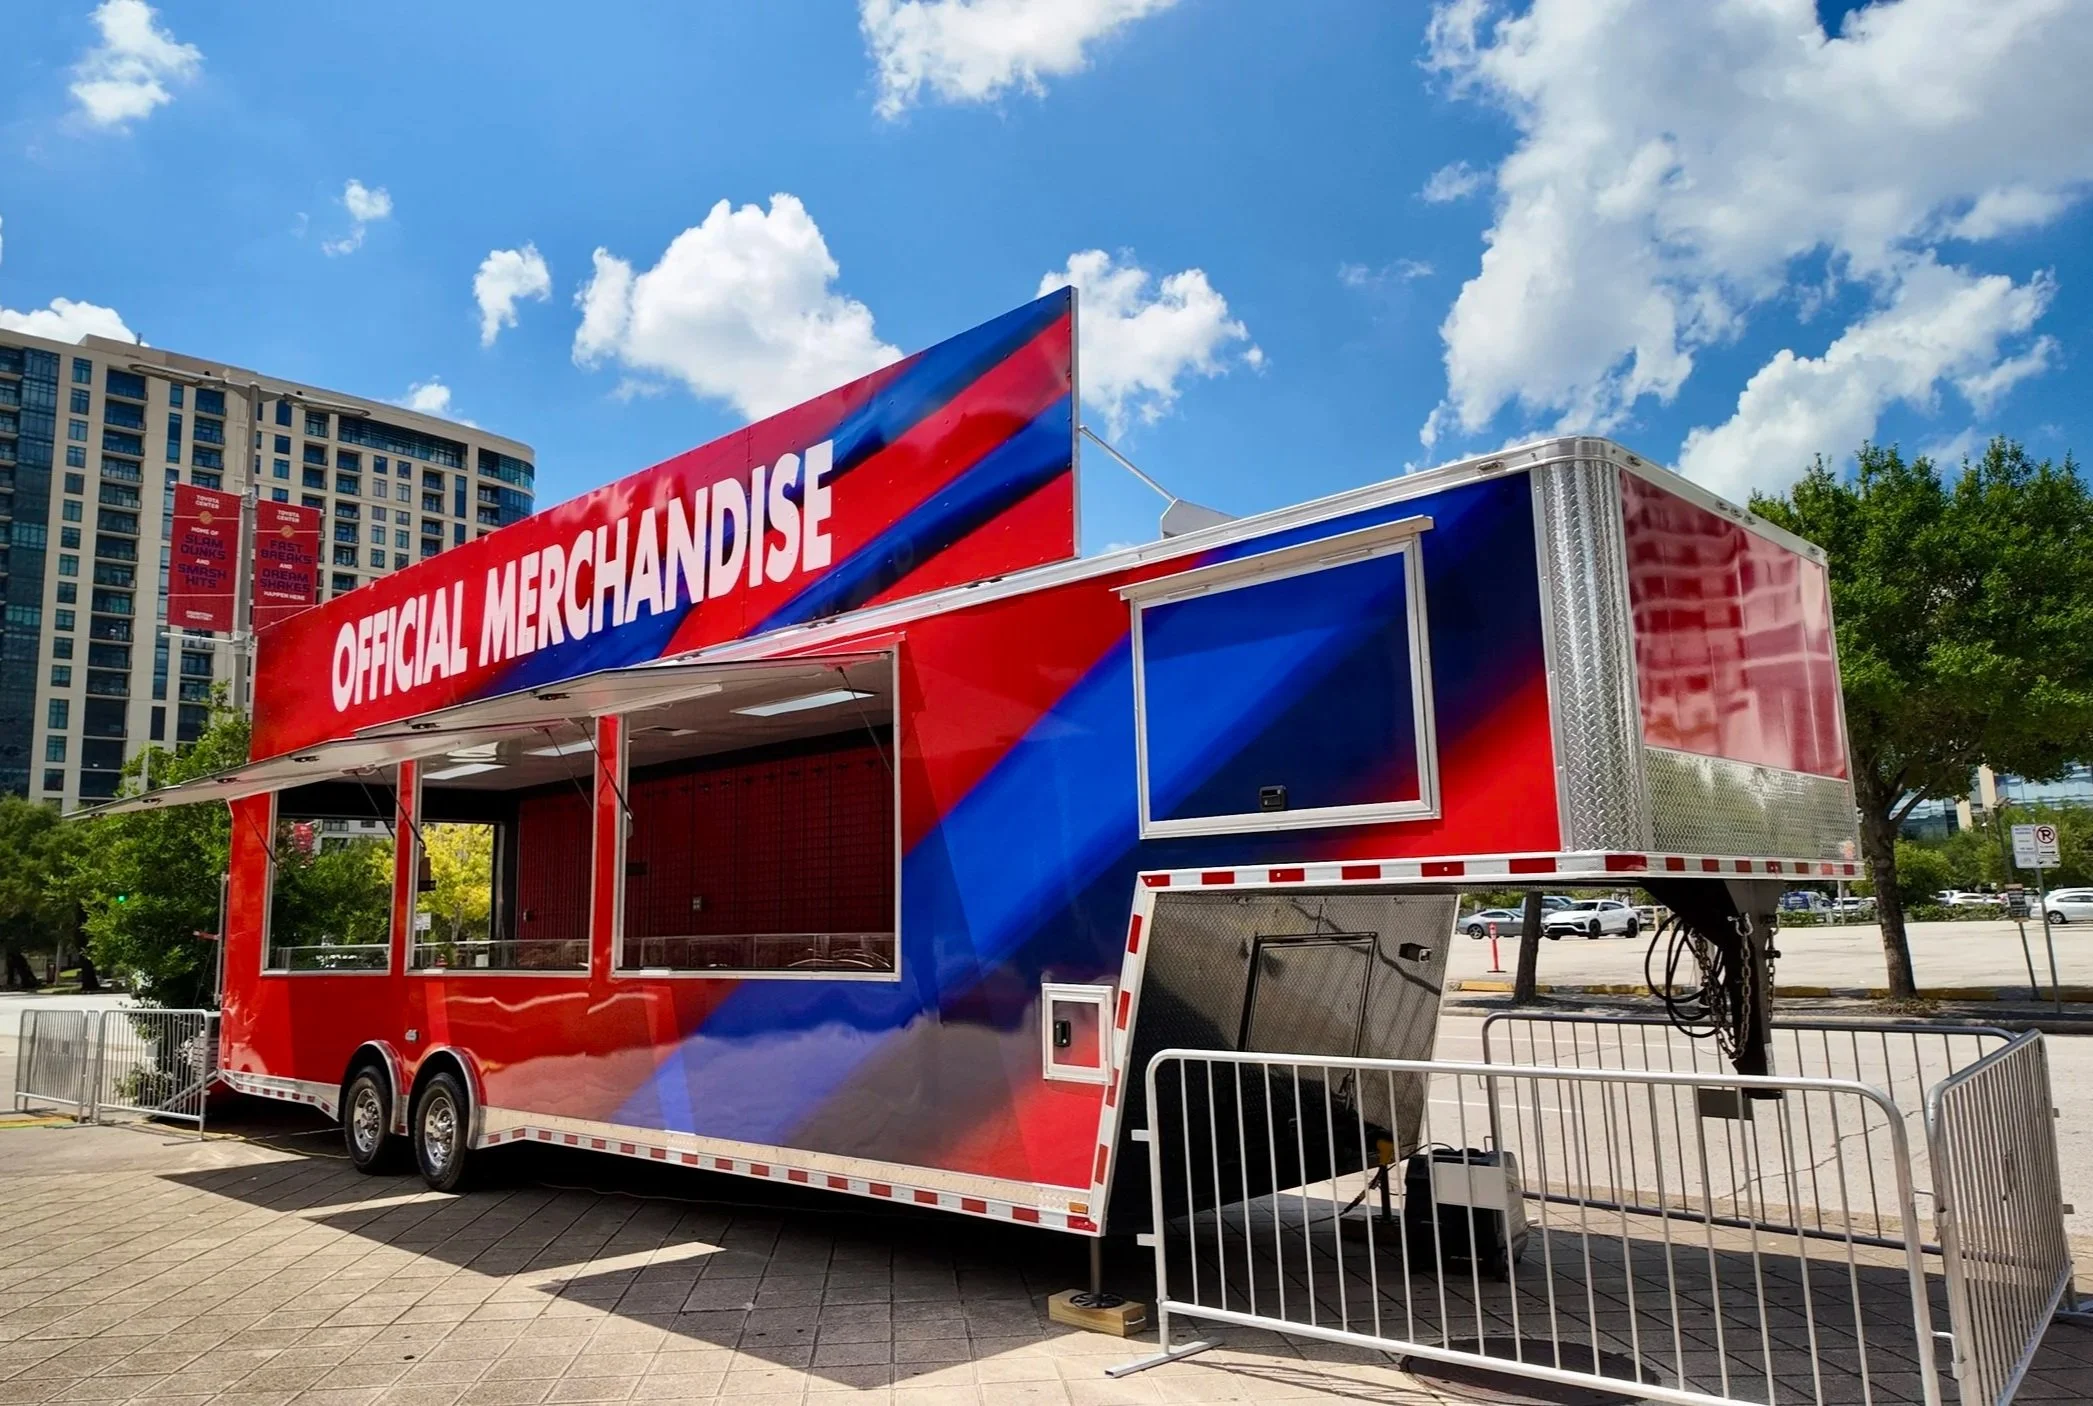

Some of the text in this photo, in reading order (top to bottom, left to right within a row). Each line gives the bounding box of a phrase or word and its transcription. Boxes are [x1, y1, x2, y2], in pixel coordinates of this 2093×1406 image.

[195, 500, 219, 509] CENTER
[196, 495, 219, 503] TOYOTA
[184, 534, 224, 549] SLAM
[270, 540, 304, 553] FAST
[181, 544, 226, 560] DUNKS
[260, 549, 312, 564] BREAKS
[178, 564, 227, 579] SMASH
[262, 568, 309, 583] DREAM
[332, 440, 834, 712] OFFICIAL MERCHANDISE
[185, 575, 217, 588] HITS
[260, 578, 311, 592] SHAKES
